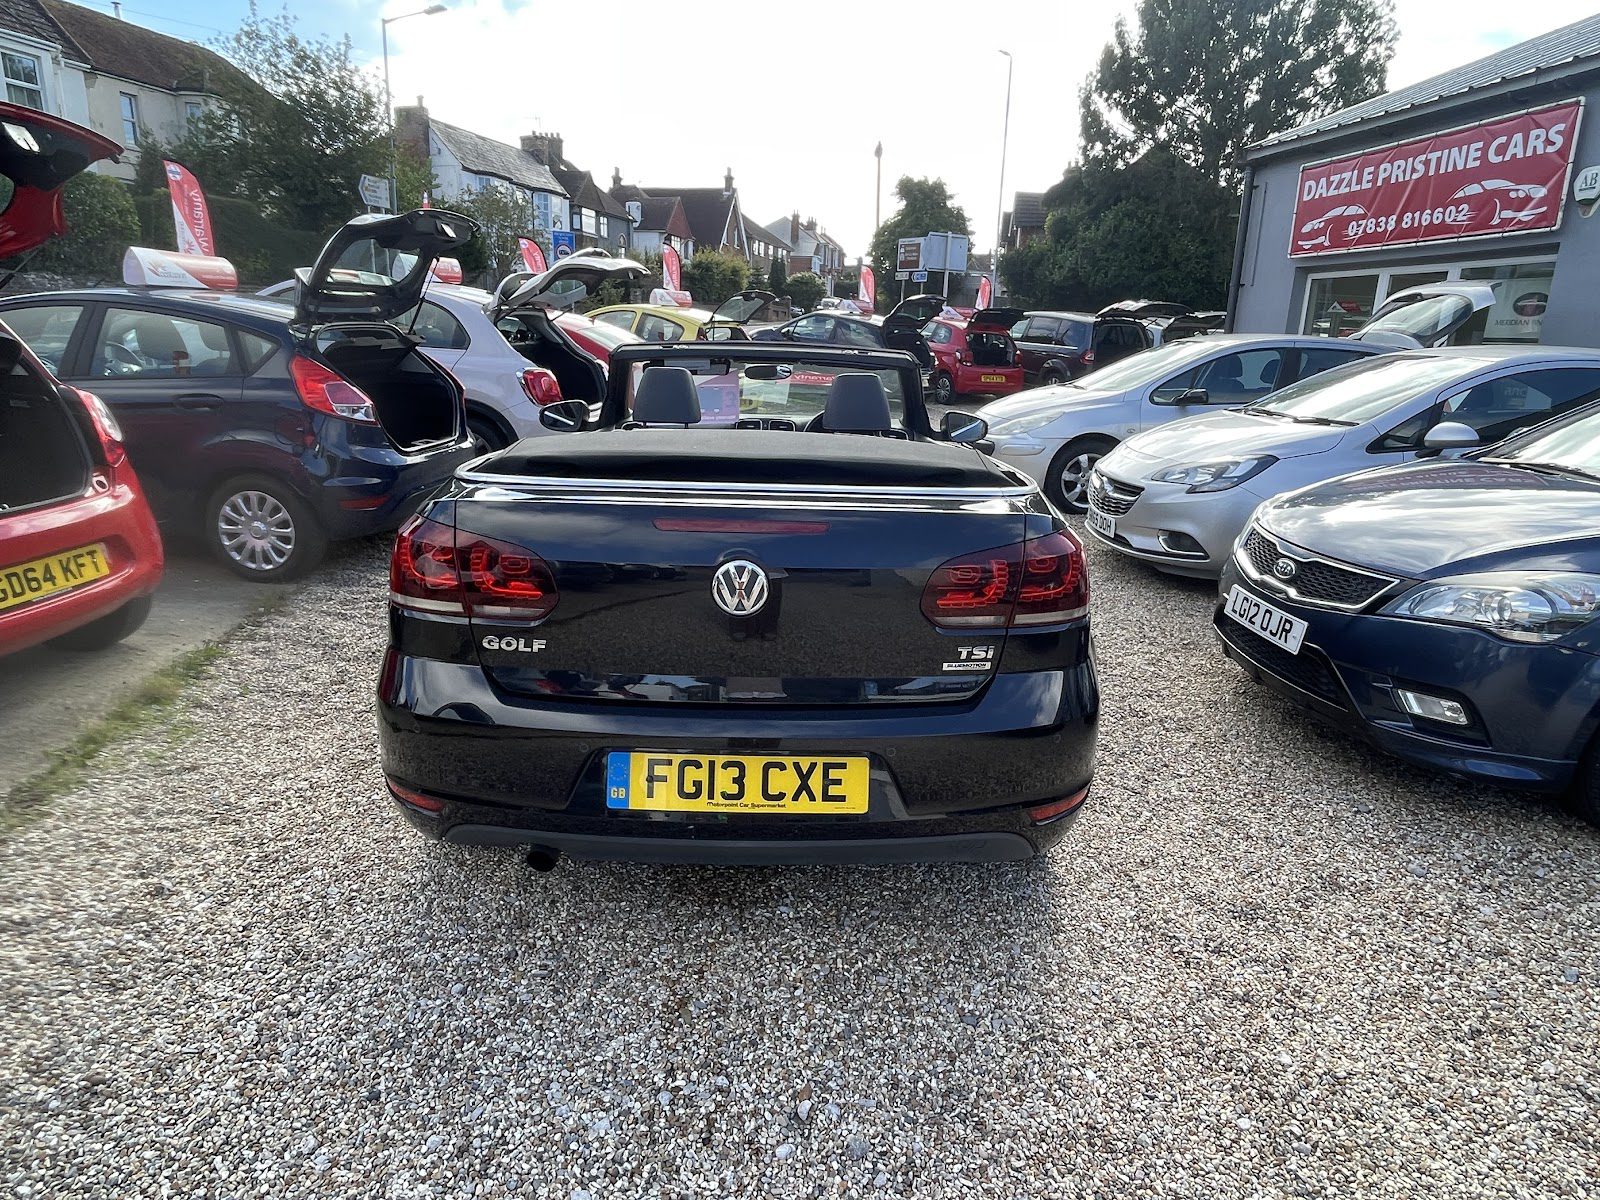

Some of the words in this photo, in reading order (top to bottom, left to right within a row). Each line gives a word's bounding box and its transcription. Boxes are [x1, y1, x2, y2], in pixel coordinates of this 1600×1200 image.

[1303, 168, 1374, 201] DAZZLE
[1377, 141, 1483, 186] PRISTINE
[1487, 123, 1567, 164] CARS
[1580, 172, 1598, 187] AB
[1348, 214, 1396, 236] 07838
[1401, 203, 1468, 229] 816602
[59, 550, 100, 582] KFT
[1231, 592, 1260, 625] LG12
[1260, 609, 1293, 643] OJR
[482, 634, 547, 653] GOLF
[610, 787, 626, 799] GB
[646, 758, 746, 800] FG13
[762, 761, 847, 802] CXE
